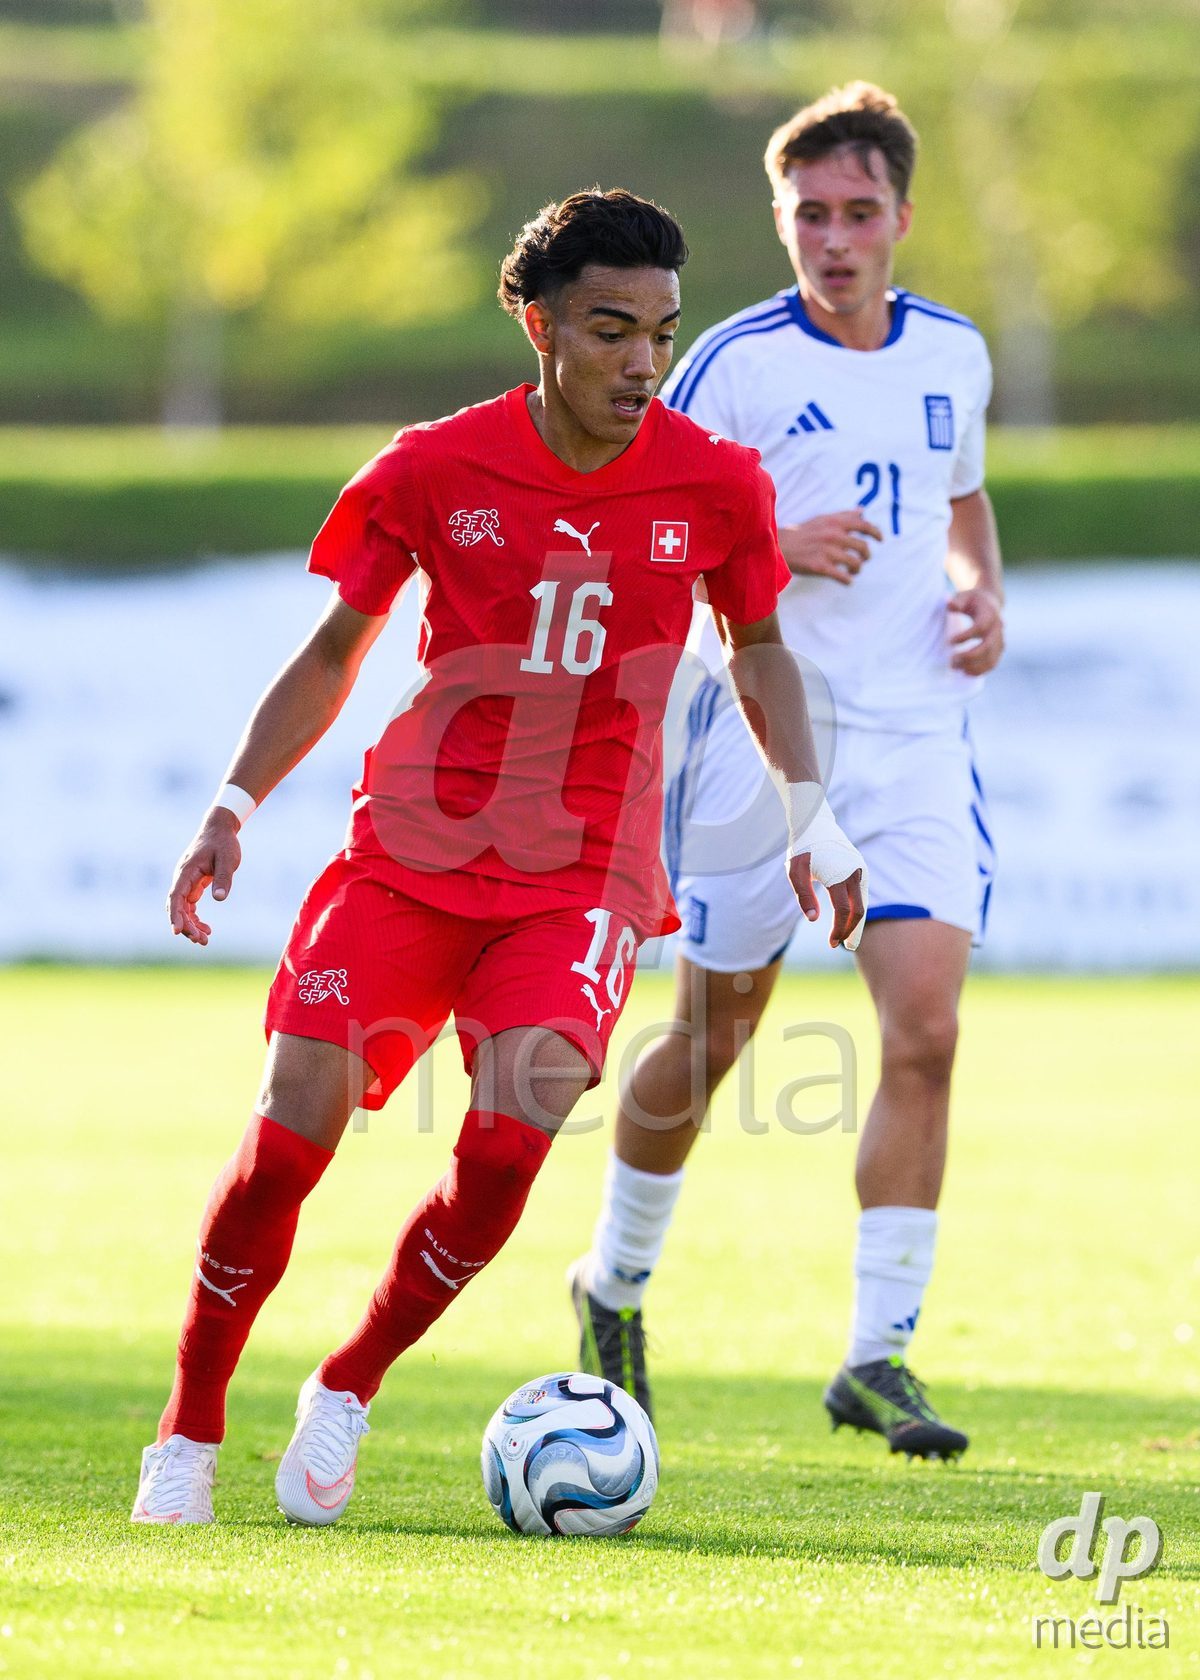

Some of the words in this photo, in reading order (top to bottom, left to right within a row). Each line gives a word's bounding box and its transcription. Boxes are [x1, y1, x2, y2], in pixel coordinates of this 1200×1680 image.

[856, 462, 901, 535] 21
[519, 580, 614, 676] 16
[570, 907, 636, 1009] 16
